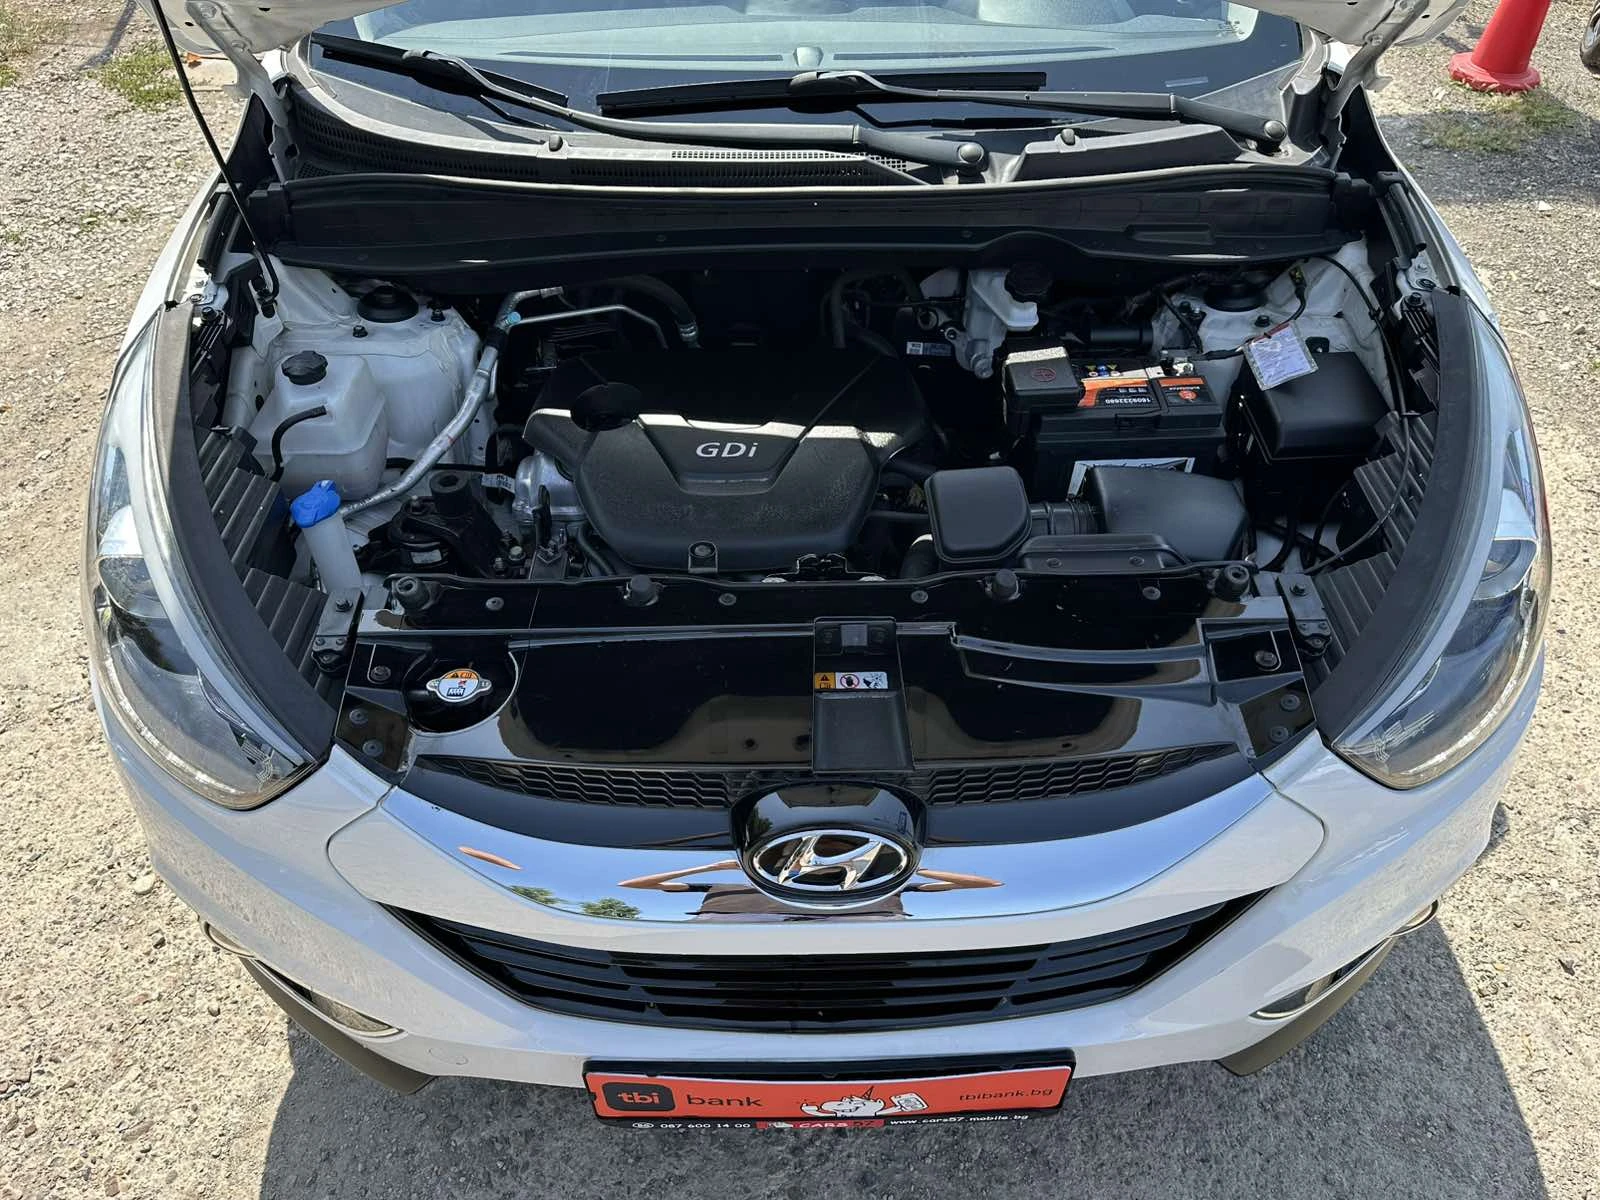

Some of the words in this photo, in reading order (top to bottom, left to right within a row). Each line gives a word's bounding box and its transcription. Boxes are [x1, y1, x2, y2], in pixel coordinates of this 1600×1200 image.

[696, 442, 758, 458] GDi
[618, 1092, 660, 1105] tbi
[687, 1094, 763, 1107] bank
[959, 1087, 1053, 1102] tbibank.bg
